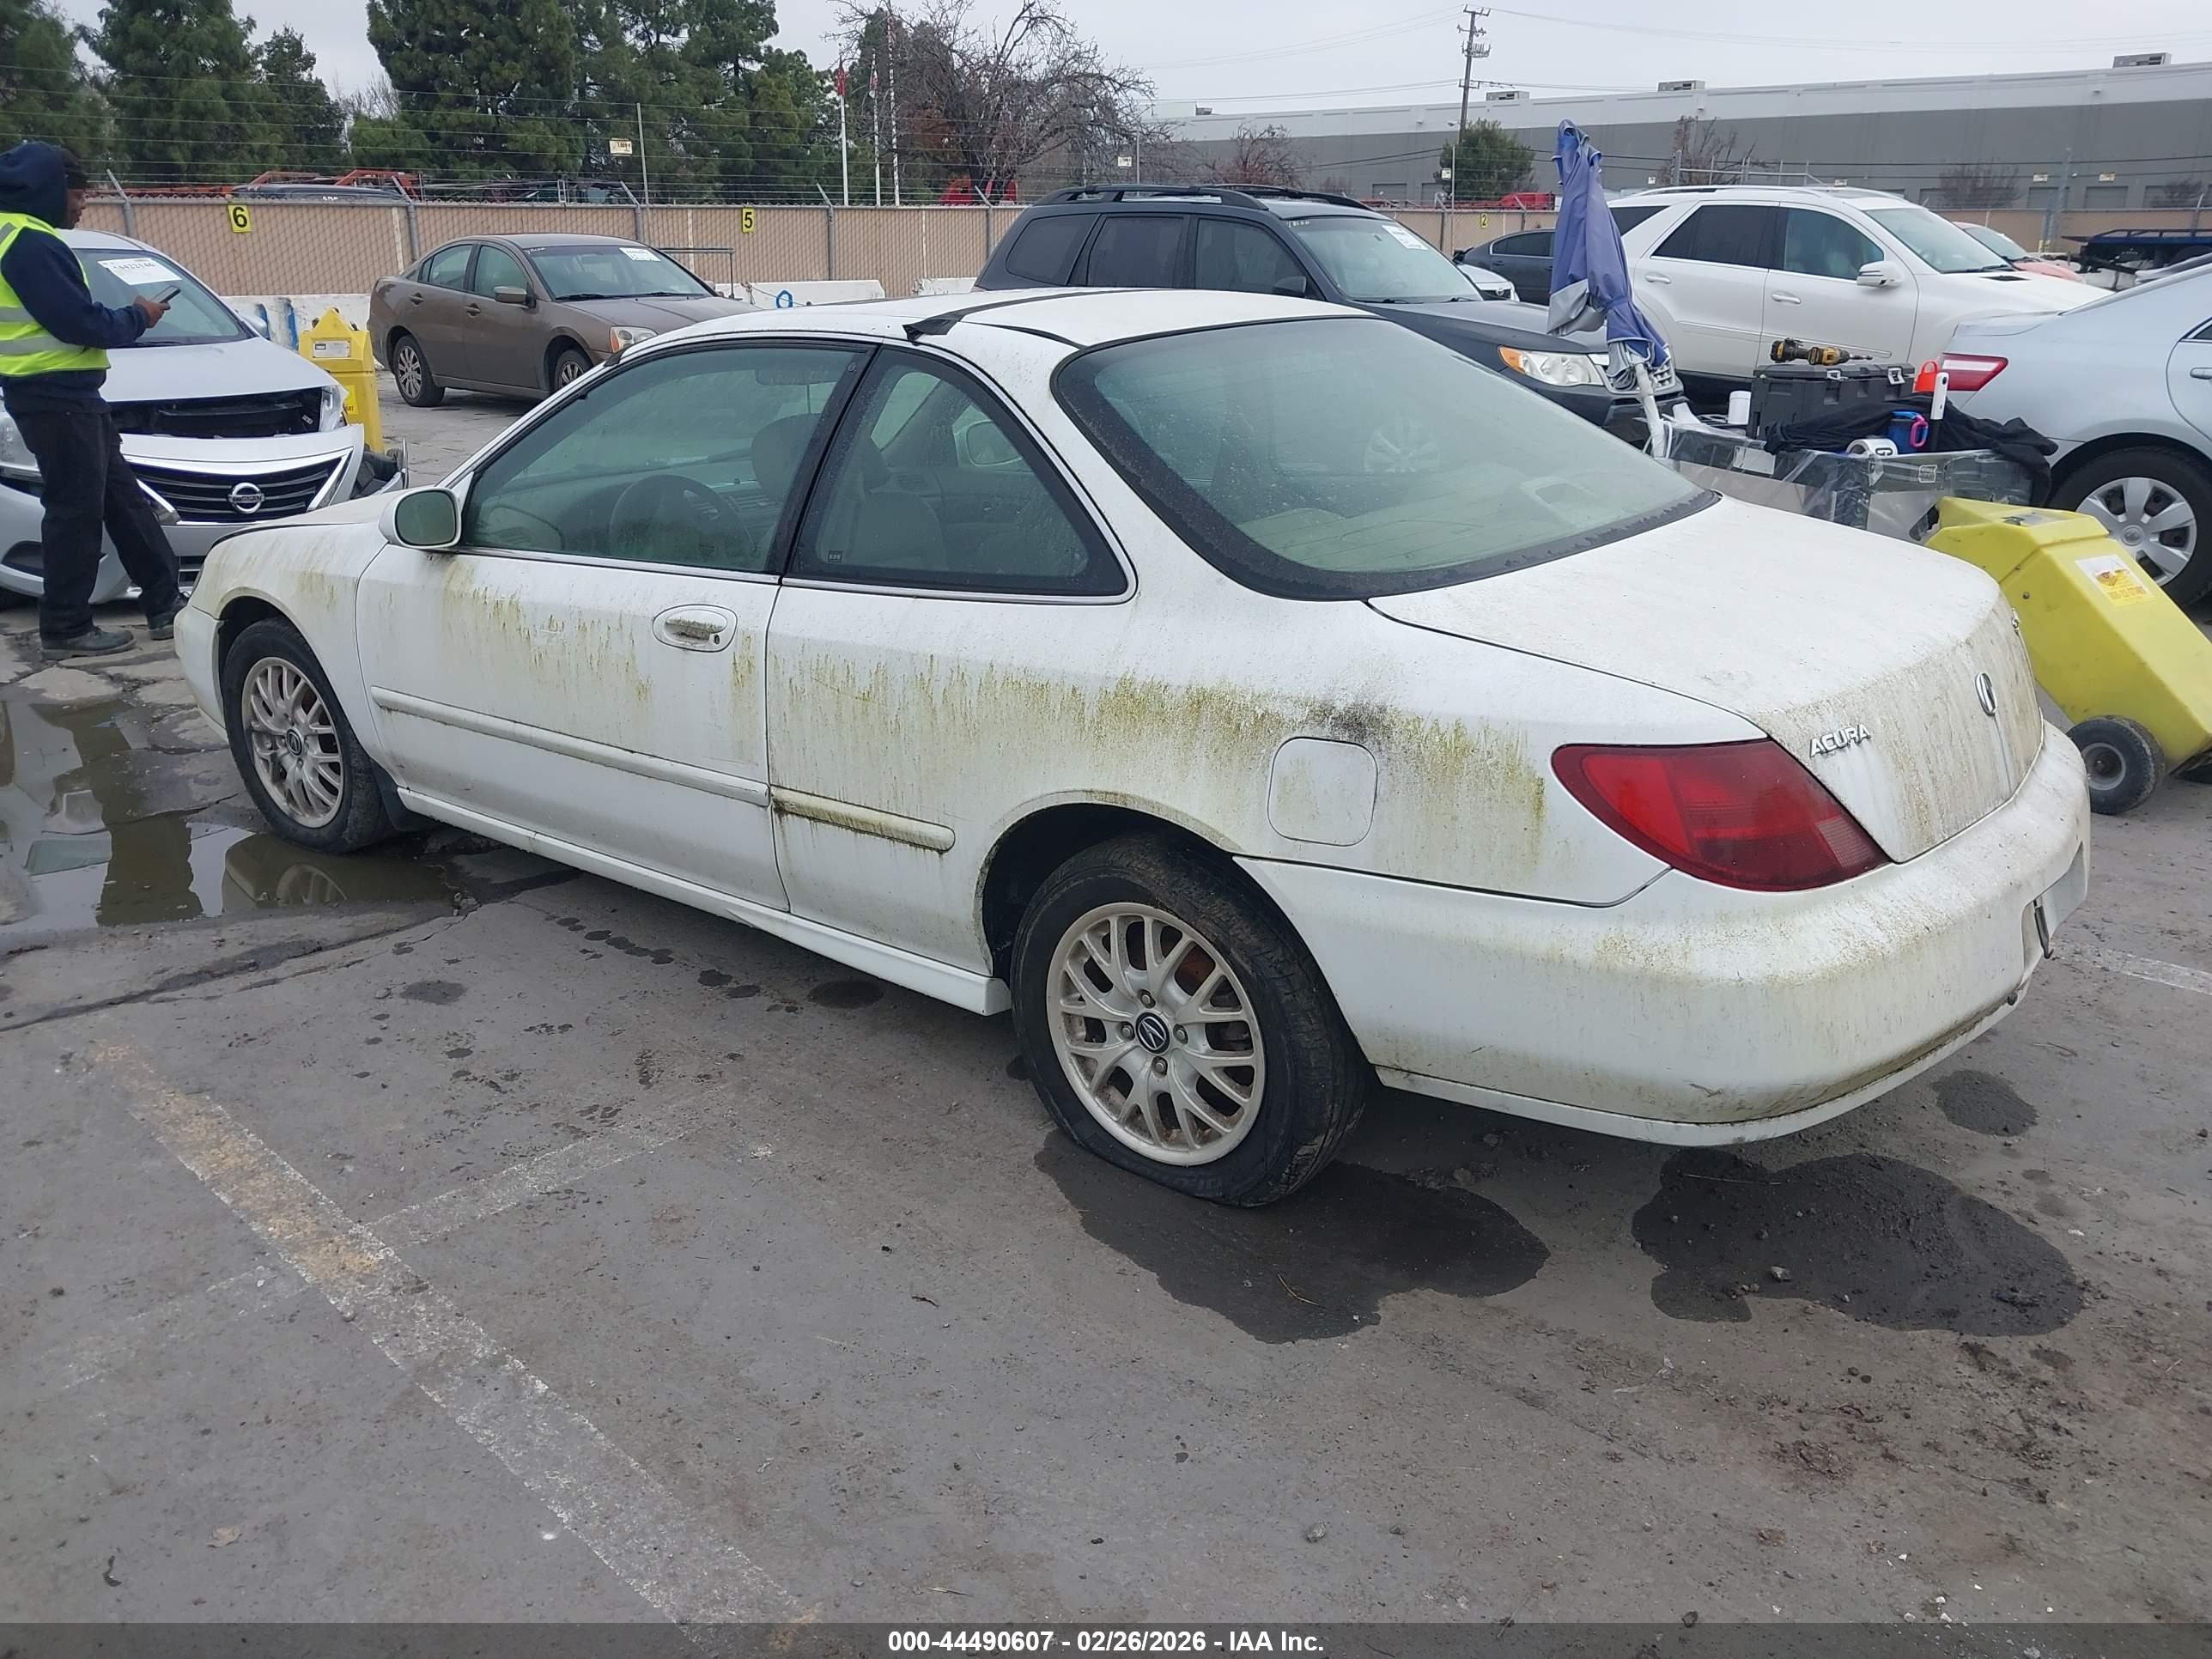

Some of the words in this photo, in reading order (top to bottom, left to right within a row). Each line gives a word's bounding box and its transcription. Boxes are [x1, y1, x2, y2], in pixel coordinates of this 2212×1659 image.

[233, 206, 247, 228] 6
[744, 212, 753, 228] 5
[1482, 215, 1486, 226] 2
[1809, 724, 1871, 758] ACURA
